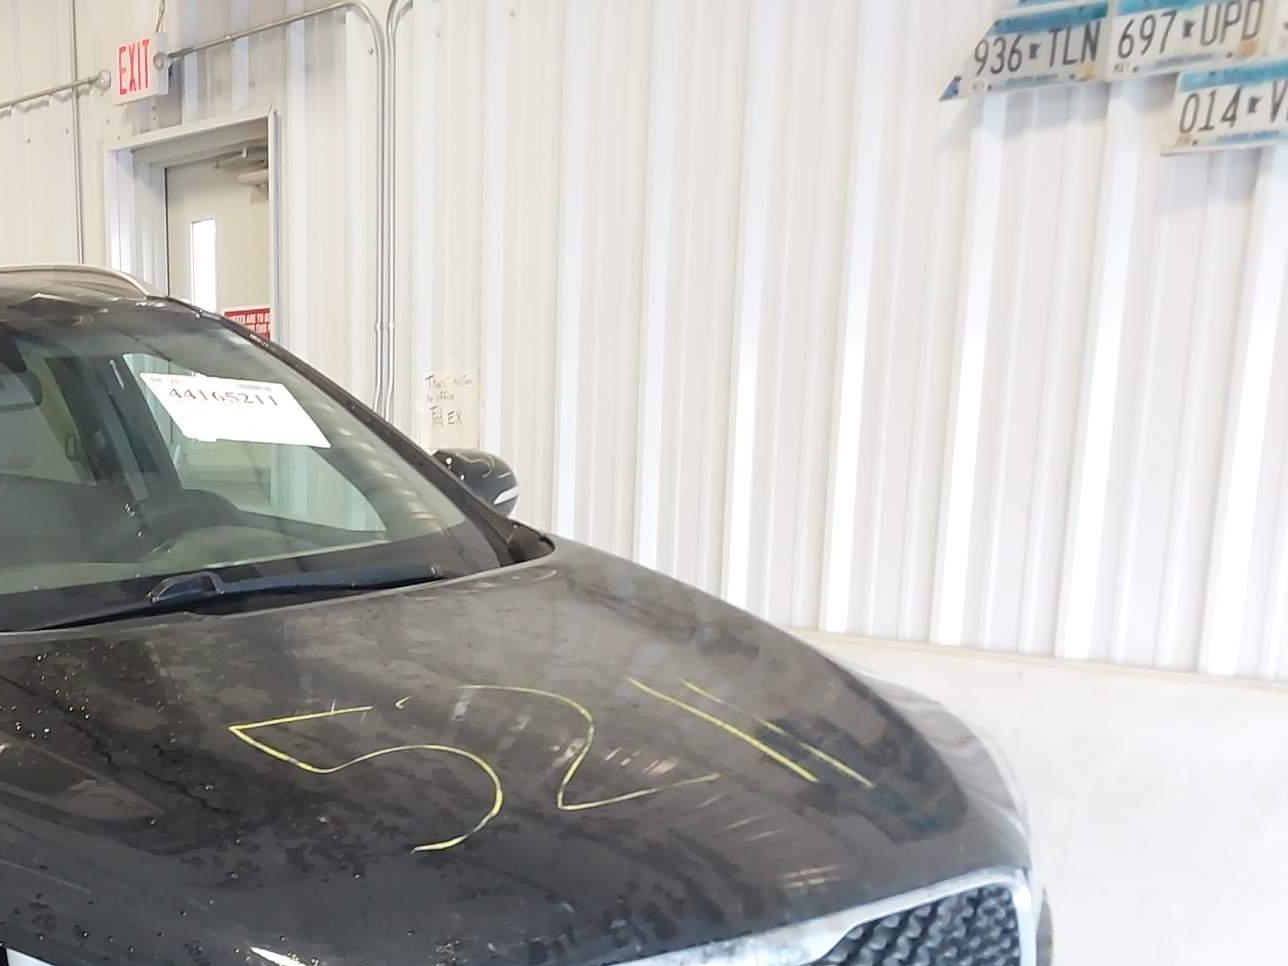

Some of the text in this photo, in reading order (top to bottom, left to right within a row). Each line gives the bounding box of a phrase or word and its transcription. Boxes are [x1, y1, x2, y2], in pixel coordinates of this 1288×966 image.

[974, 22, 1101, 76] 936 TLN
[1118, 9, 1177, 59] 697
[1200, 0, 1264, 46] UPD
[119, 39, 151, 95] EXIT
[1179, 79, 1288, 133] 014 V
[169, 388, 278, 406] 44165211
